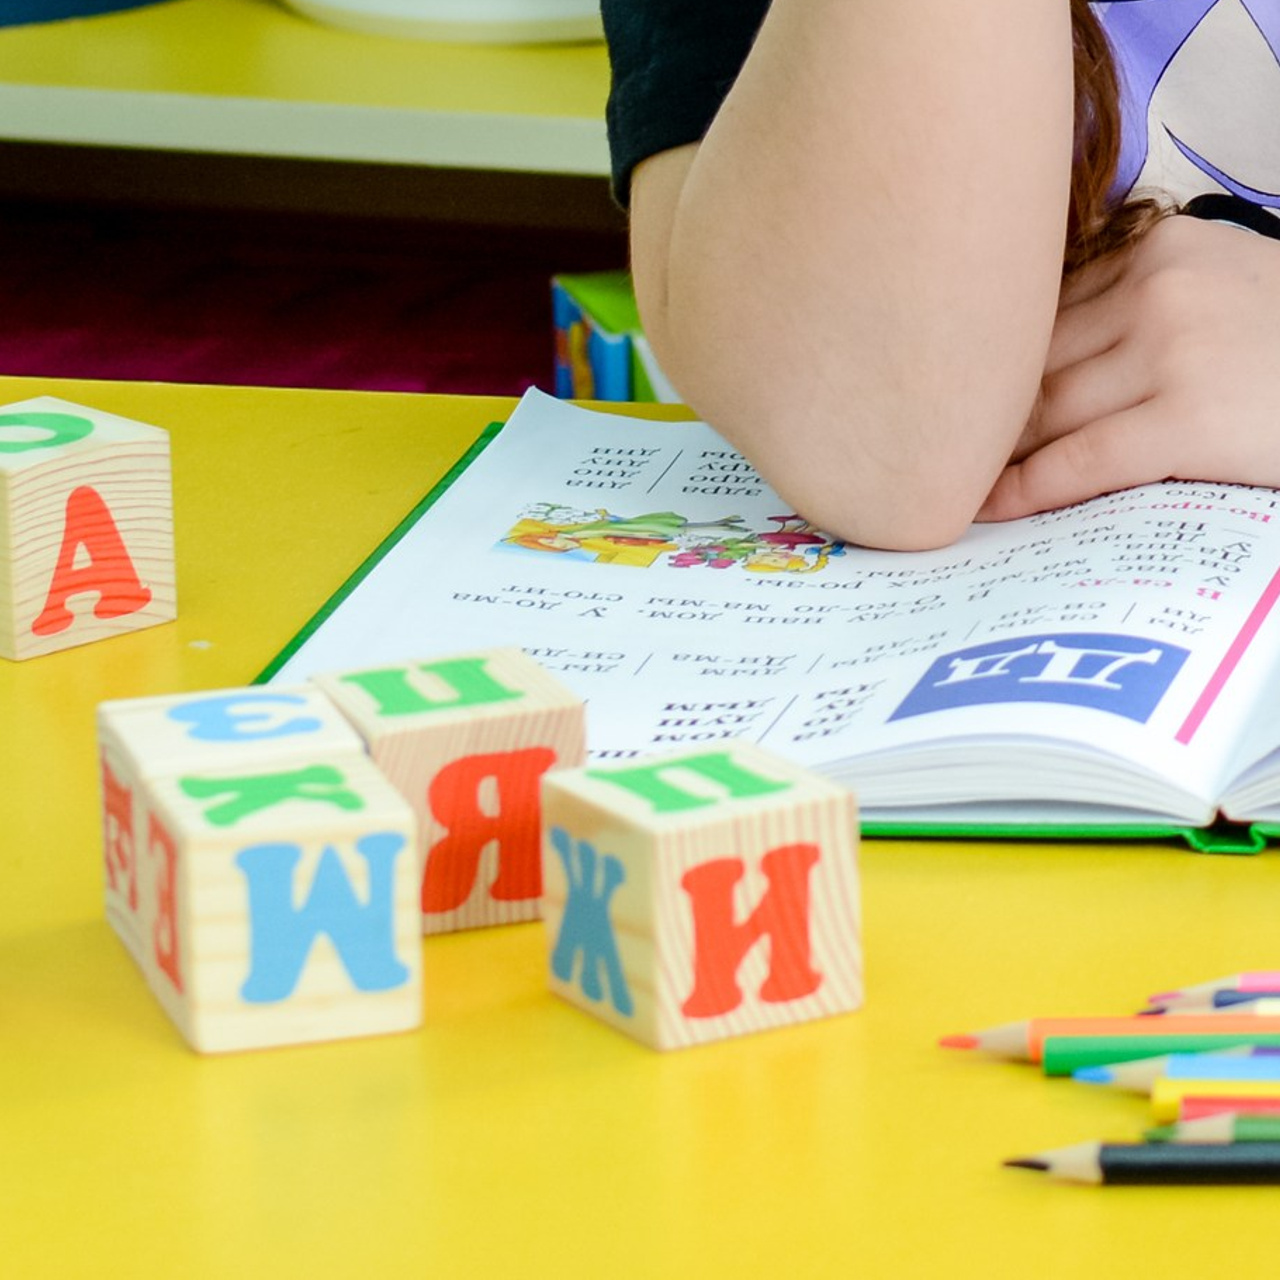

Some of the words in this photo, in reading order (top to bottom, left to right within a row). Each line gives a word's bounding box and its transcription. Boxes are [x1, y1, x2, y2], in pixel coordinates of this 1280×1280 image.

[31, 484, 153, 636] А
[420, 746, 558, 916] Я
[549, 825, 635, 1018] Ж
[680, 843, 825, 1020] И
